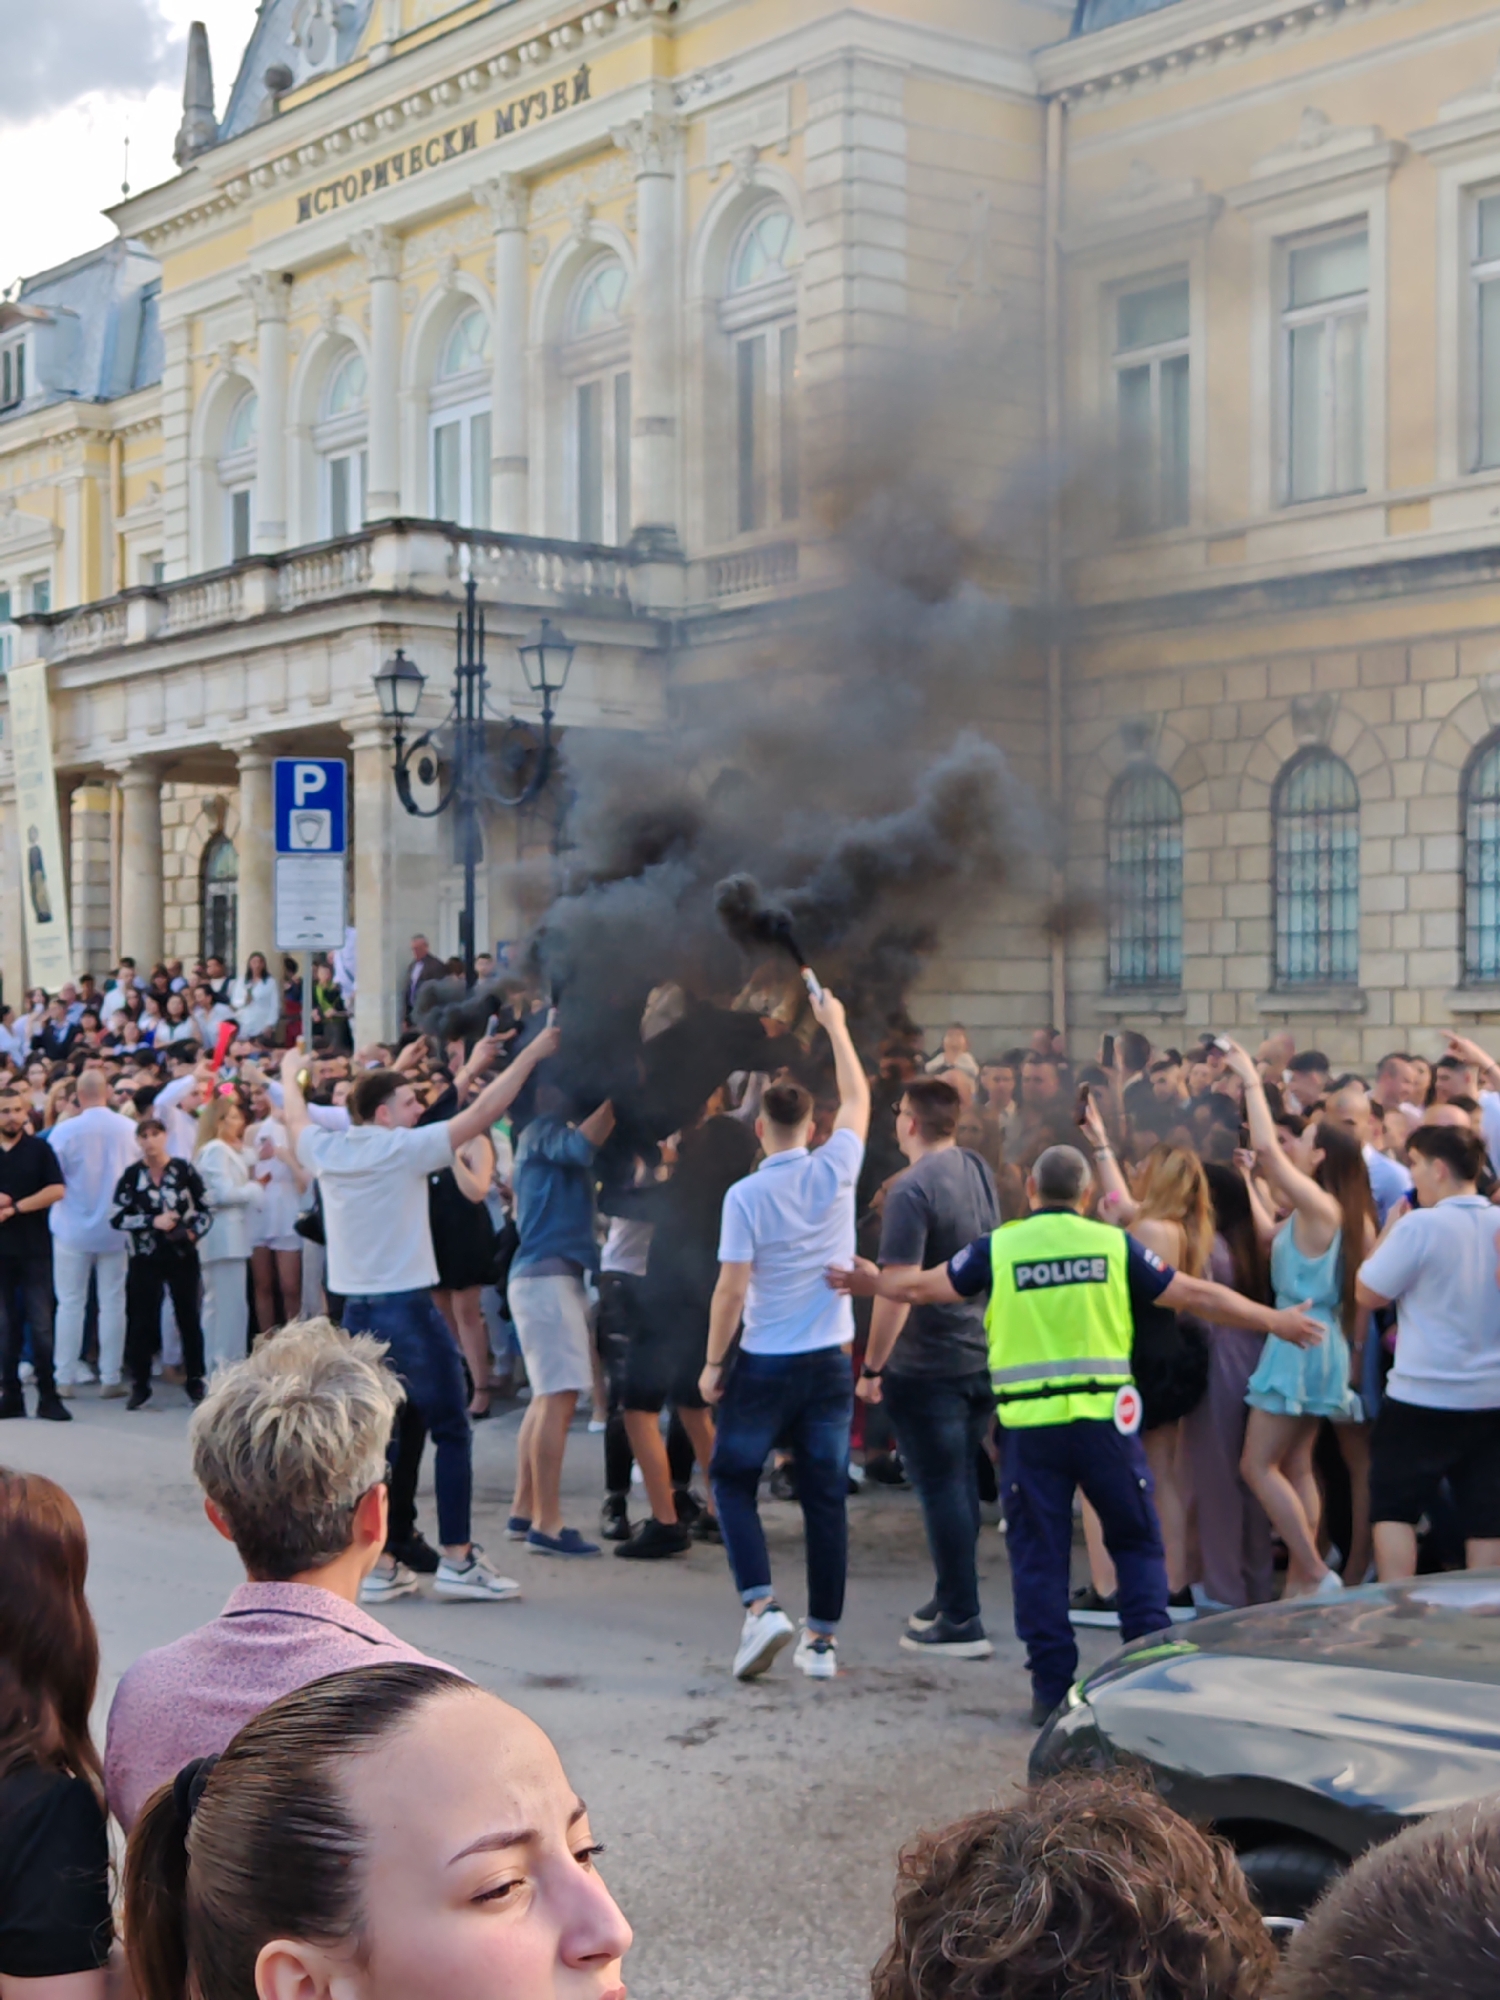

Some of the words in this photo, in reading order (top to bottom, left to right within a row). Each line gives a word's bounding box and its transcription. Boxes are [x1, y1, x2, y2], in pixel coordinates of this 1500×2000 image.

[297, 119, 479, 224] ИСТОРИЧЕСКИ
[494, 63, 591, 139] МУЗЕЙ
[294, 764, 326, 807] P
[1017, 1258, 1105, 1288] POLICE
